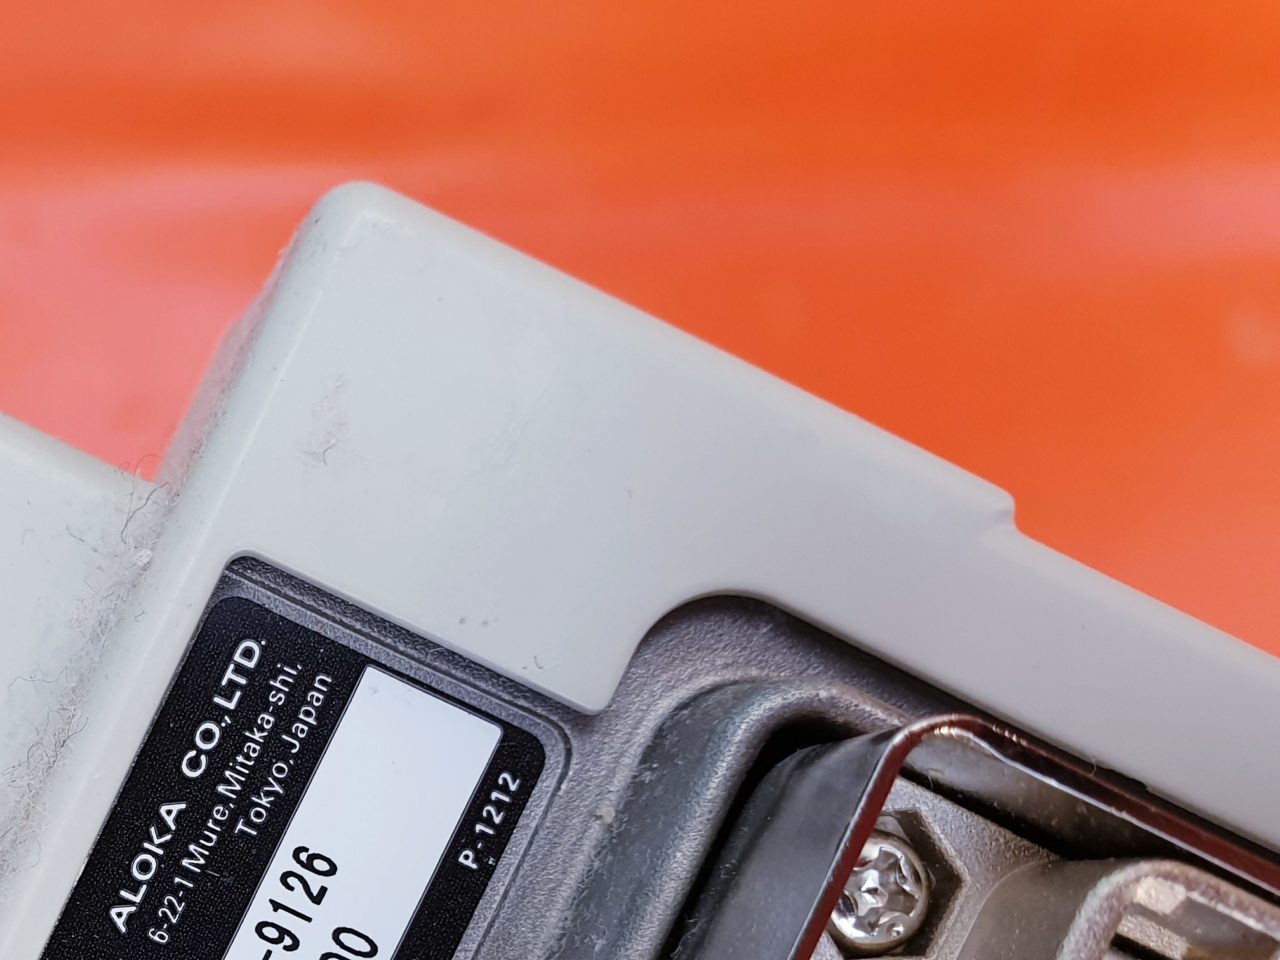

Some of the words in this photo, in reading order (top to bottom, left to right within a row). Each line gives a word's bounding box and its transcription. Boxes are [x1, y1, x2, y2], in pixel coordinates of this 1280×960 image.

[109, 801, 187, 933] ALOKA
[458, 772, 521, 870] P-1212
[148, 876, 195, 945] 6-22-1
